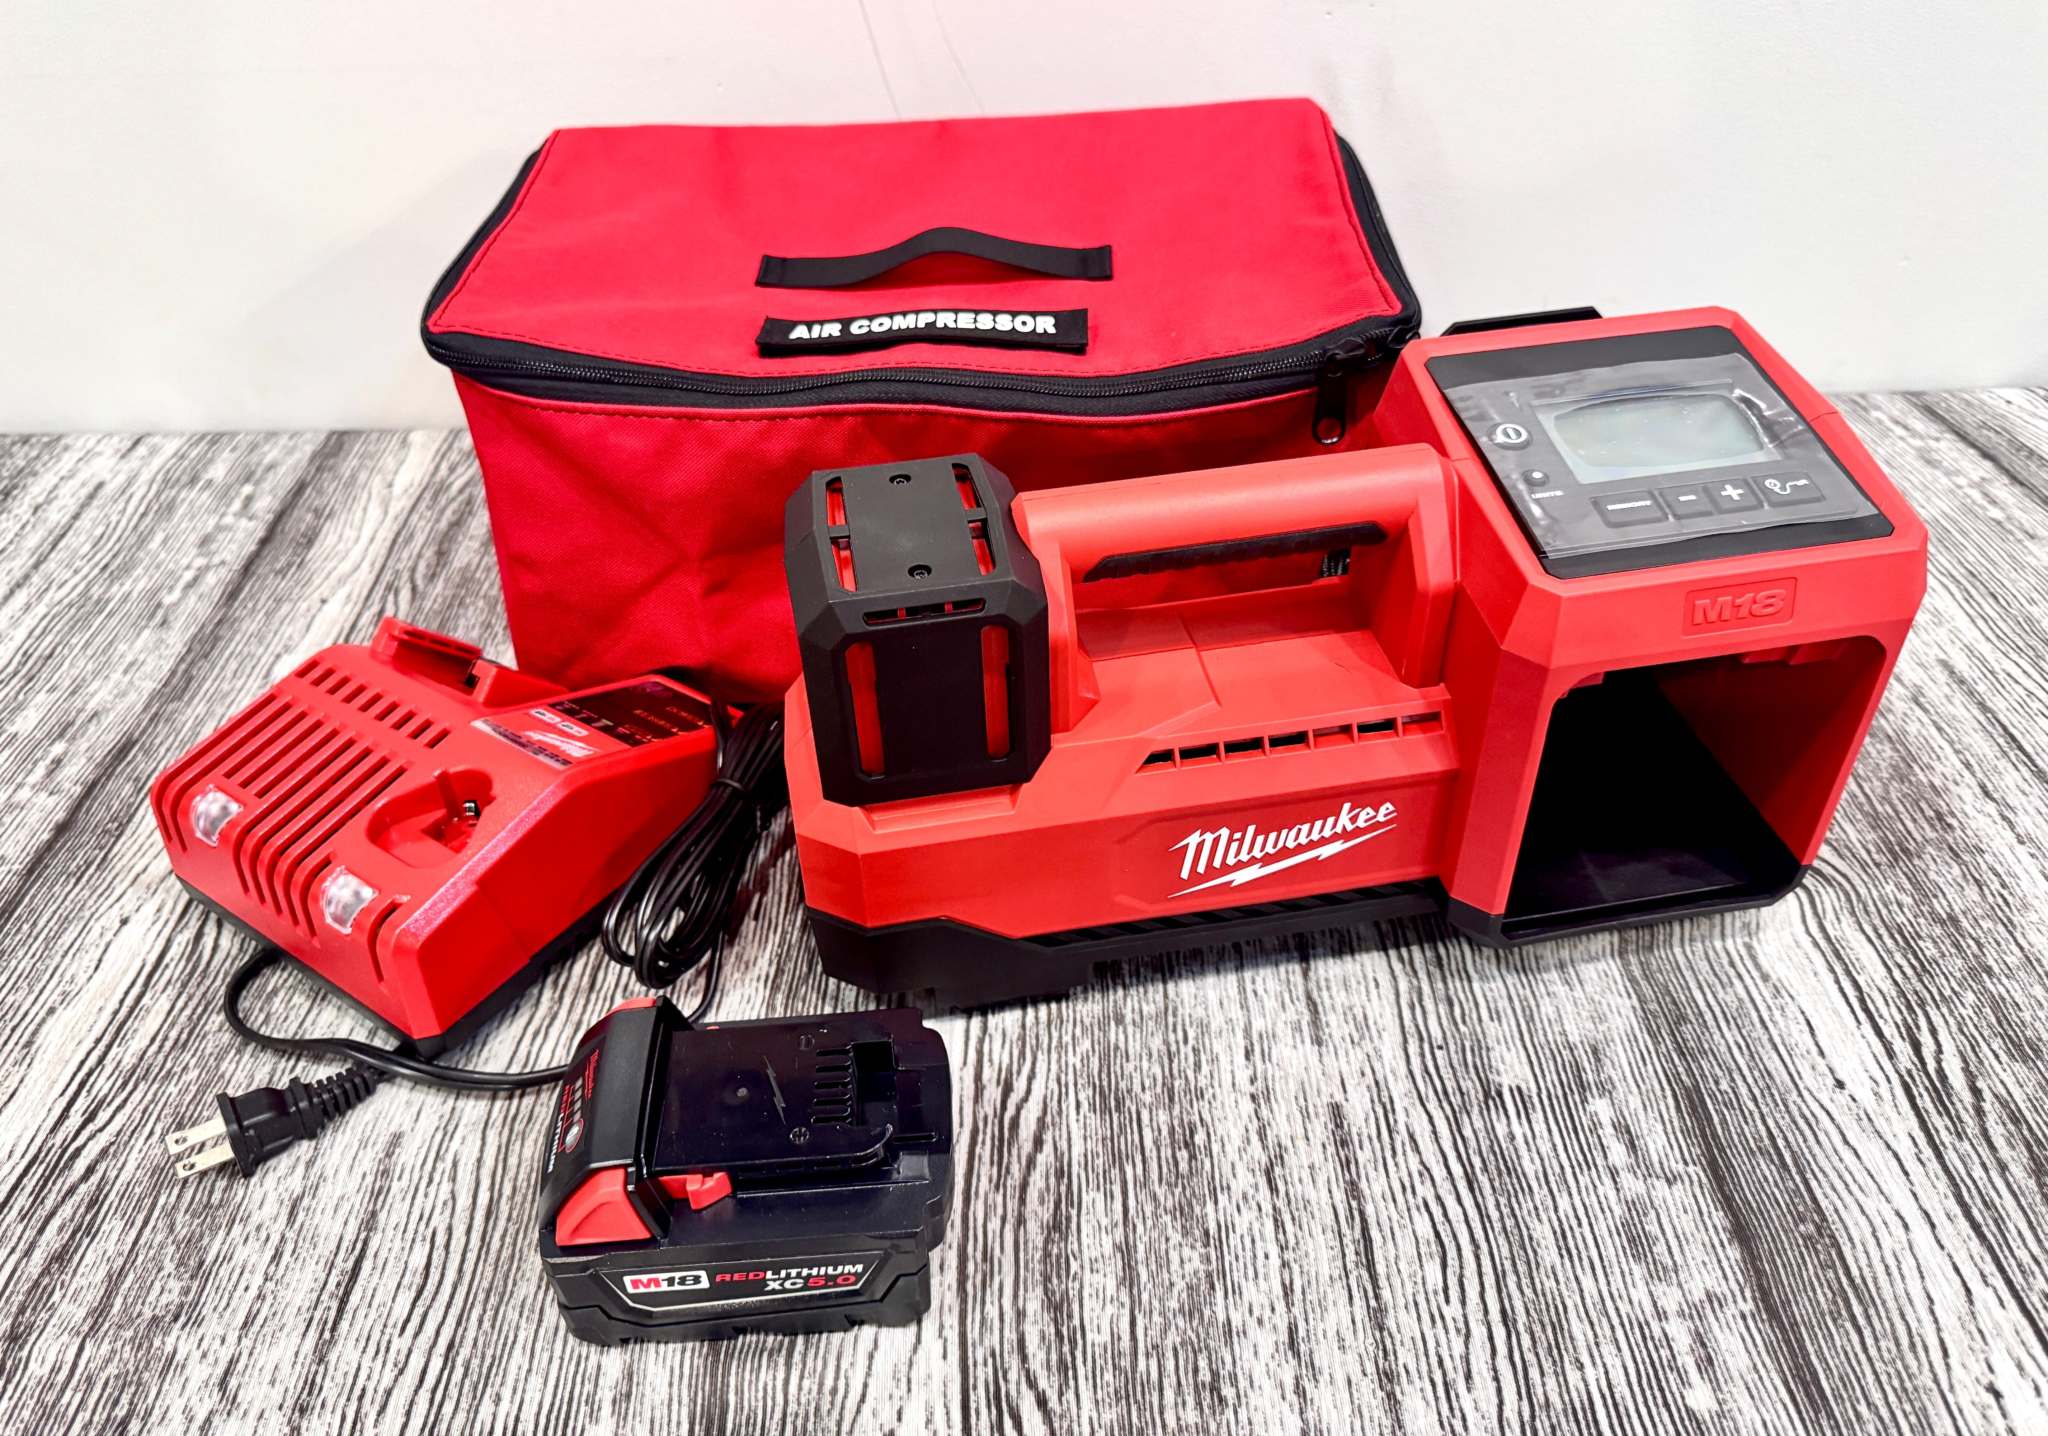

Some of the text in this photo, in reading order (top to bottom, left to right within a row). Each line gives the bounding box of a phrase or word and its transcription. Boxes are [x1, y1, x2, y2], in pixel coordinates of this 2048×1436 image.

[788, 311, 1057, 340] AIR COMPRESSOR
[1692, 588, 1786, 625] M18
[1168, 801, 1398, 881] Milwaukee
[629, 1273, 704, 1291] M18
[715, 1263, 863, 1282] REDLITHIUM
